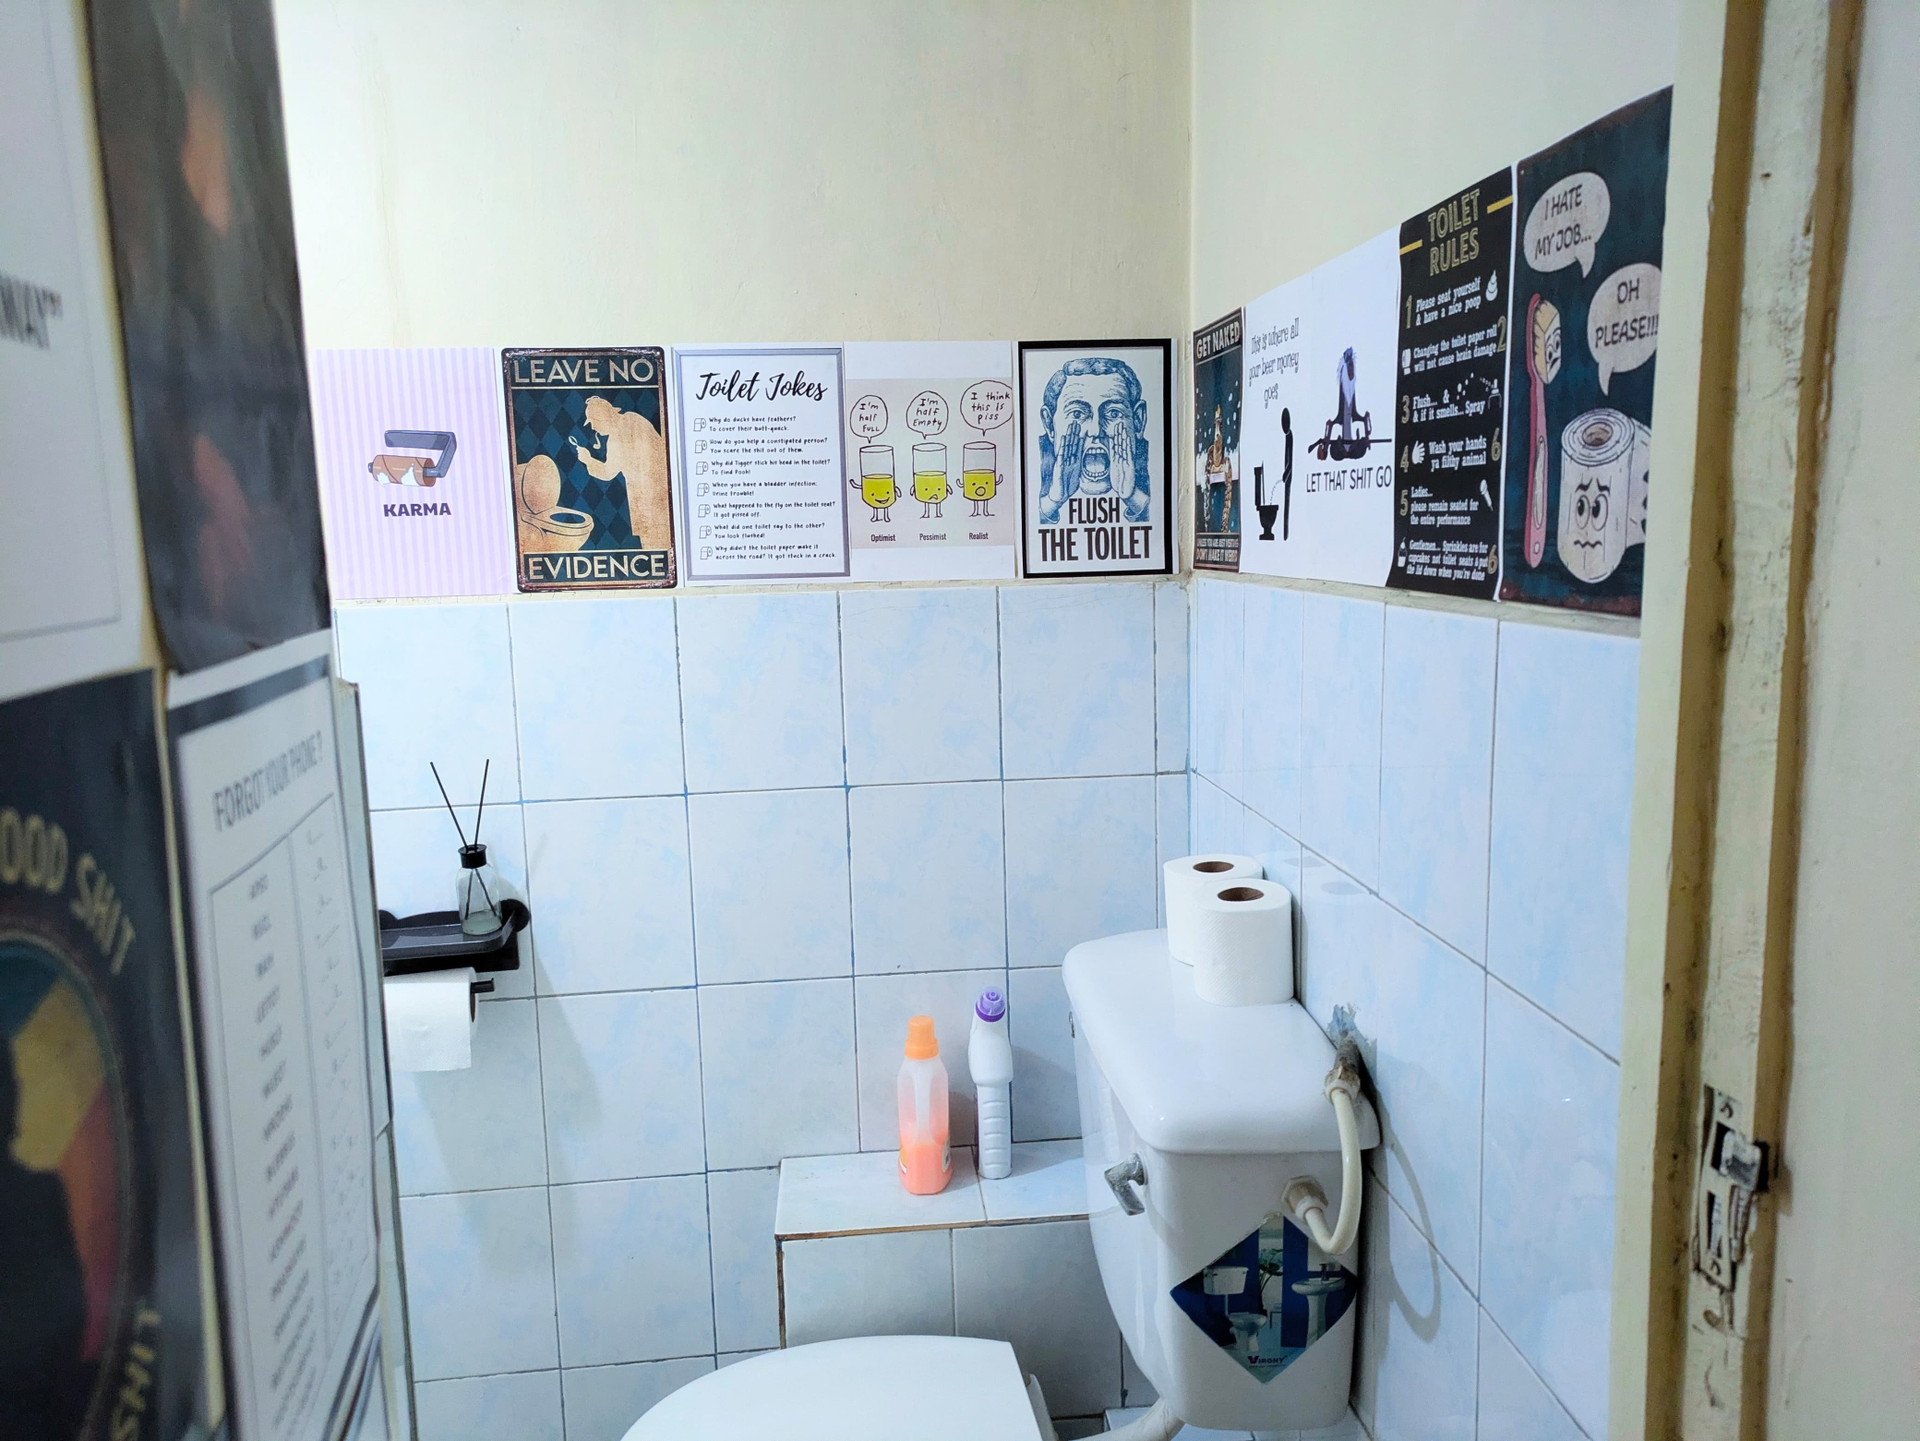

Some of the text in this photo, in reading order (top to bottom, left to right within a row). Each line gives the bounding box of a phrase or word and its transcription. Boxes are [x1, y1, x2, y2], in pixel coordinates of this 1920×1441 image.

[1428, 188, 1480, 242] TOILET
[1544, 184, 1583, 221] I HATE
[1430, 227, 1479, 276] RULES
[1535, 224, 1591, 259] MY JOB...
[1416, 276, 1481, 312] Please seat yourself
[1617, 278, 1640, 303] OH
[1424, 311, 1438, 324] have
[1441, 308, 1445, 318] a
[1448, 302, 1462, 315] nice
[1465, 296, 1481, 313] poop
[1197, 321, 1240, 359] GET NAKED
[1251, 317, 1299, 355] This is where all
[1414, 324, 1497, 358] Changing the toilet paper roll
[1595, 313, 1659, 348] PLEASE!!!
[513, 357, 655, 384] LEAVE NO
[1414, 343, 1496, 372] will not cause brain damage
[696, 369, 828, 402] Toilet Jokes
[971, 392, 1010, 400] I think
[1264, 383, 1278, 409] goes
[859, 402, 879, 410] I'm
[916, 407, 940, 415] half
[919, 398, 938, 407] I'm
[971, 401, 990, 411] this
[1402, 395, 1409, 423] 3
[1420, 408, 1427, 421] if
[1429, 407, 1434, 420] it
[1465, 400, 1485, 416] Spray
[859, 414, 878, 422] half
[978, 413, 999, 424] piss
[1400, 445, 1409, 472] 4
[1429, 435, 1487, 455] Wash your hands
[1431, 451, 1486, 472] ya filthy animal
[1306, 465, 1392, 493] LET THAT SHIT GO
[383, 502, 452, 517] KARMA
[1068, 496, 1120, 525] FLUSH
[1400, 489, 1408, 516] 5
[870, 532, 897, 543] Optimist
[919, 531, 947, 541] Pessimist
[969, 531, 989, 541] Realist
[1037, 525, 1153, 562] THE TOILET
[527, 553, 666, 581] EVIDENCE
[69, 850, 137, 976] SHIT
